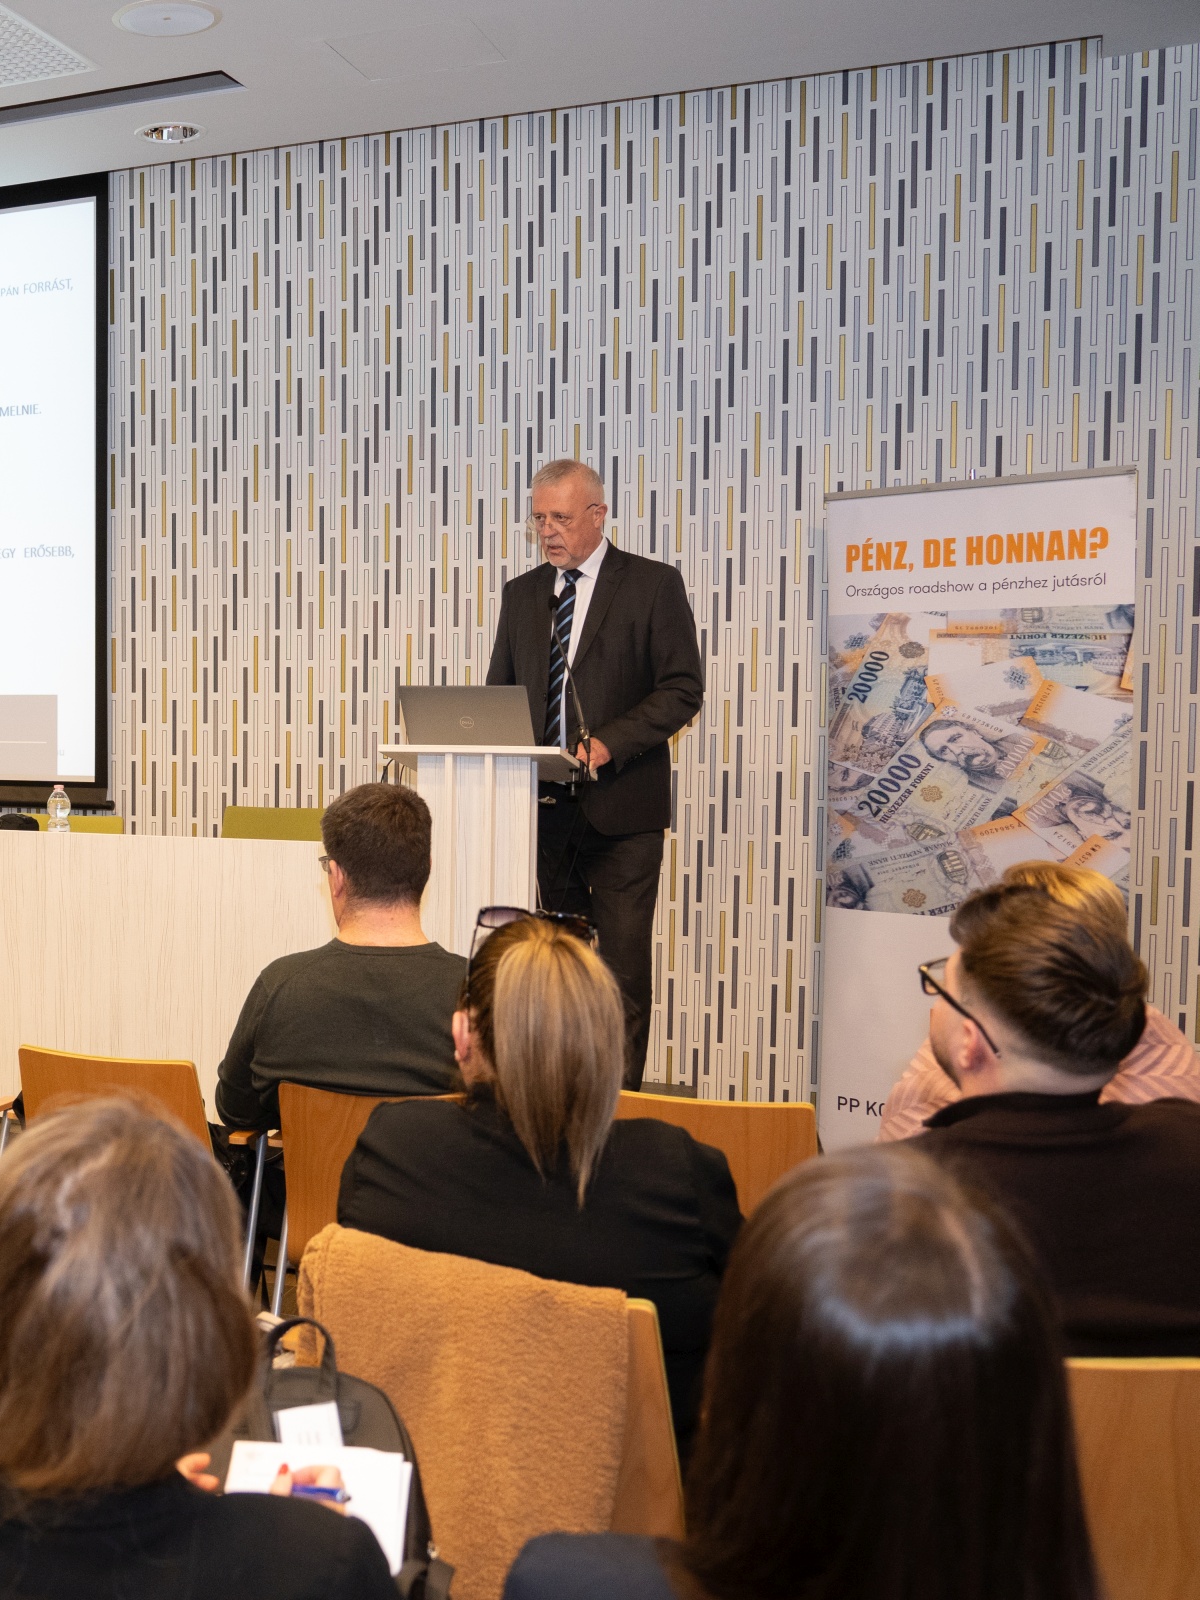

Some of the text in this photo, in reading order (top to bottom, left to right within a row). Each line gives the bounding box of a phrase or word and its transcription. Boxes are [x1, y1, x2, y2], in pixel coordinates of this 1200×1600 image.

[23, 278, 73, 296] FORRÁST,
[23, 545, 75, 559] ERŐSEBB,
[845, 526, 1109, 573] PÉNZ, DE HONNAN?
[845, 572, 1107, 599] Országos roadshow a pénzhez jutásról
[847, 650, 889, 704] 20000
[857, 753, 922, 818] 20000
[910, 762, 935, 789] FORINT
[837, 1095, 860, 1113] PP
